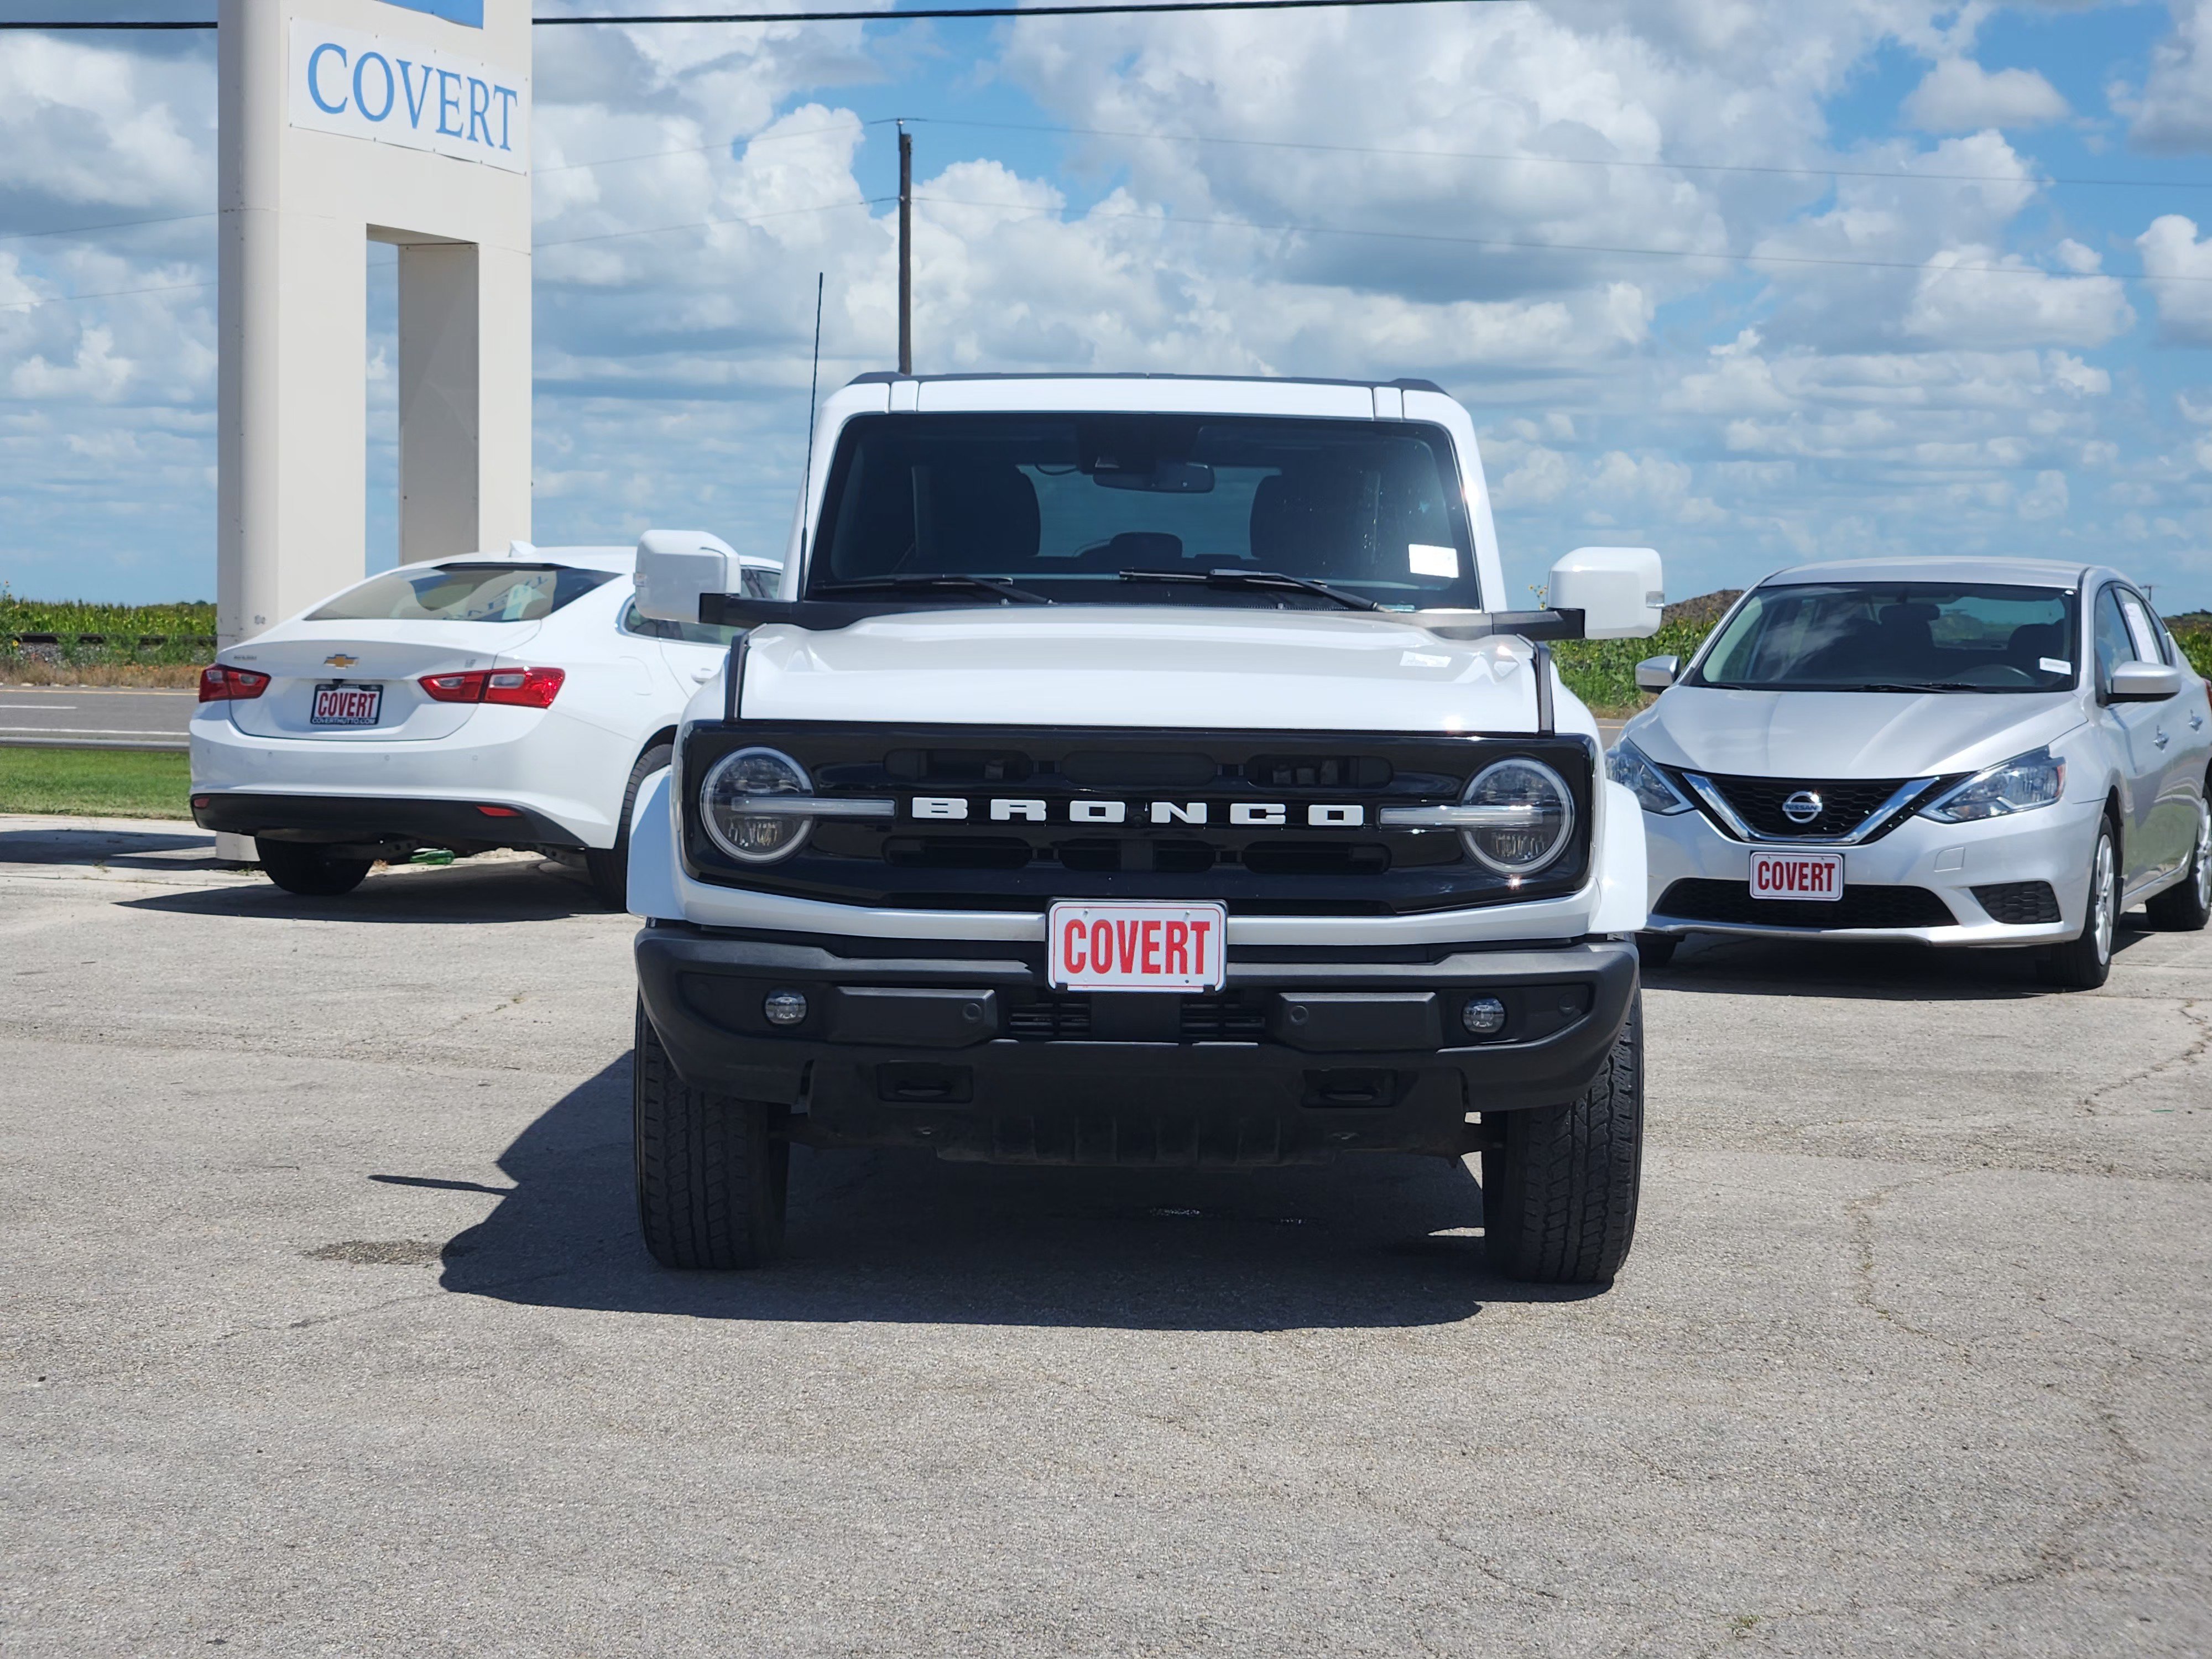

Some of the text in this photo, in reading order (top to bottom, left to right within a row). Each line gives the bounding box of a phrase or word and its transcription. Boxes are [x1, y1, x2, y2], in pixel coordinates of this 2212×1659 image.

[308, 43, 518, 152] COVERT
[318, 692, 377, 717] COVERT
[912, 797, 1364, 826] BRONCO
[1757, 860, 1835, 892] COVERT
[1064, 919, 1211, 974] COVERT
